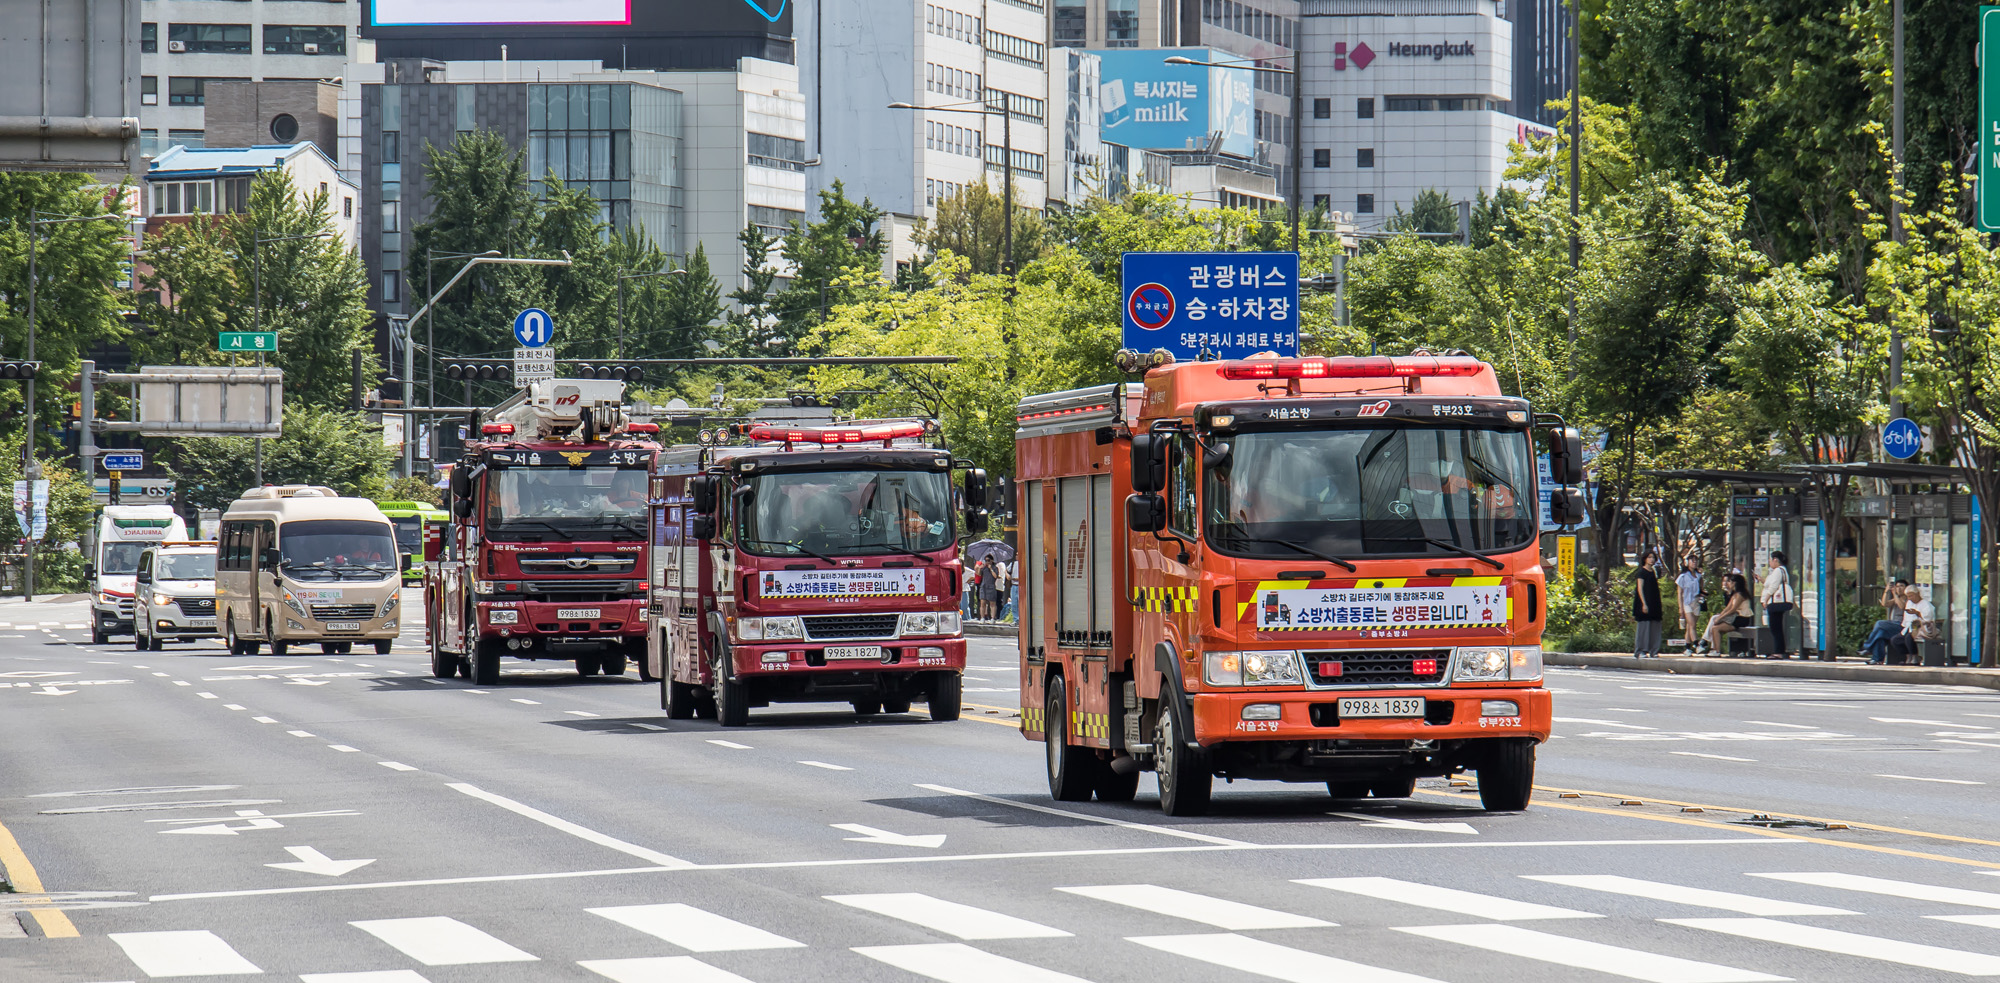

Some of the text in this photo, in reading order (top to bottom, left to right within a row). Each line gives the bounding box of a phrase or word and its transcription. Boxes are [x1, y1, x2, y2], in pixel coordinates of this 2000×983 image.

[1388, 40, 1475, 61] Heungkuk
[1133, 81, 1198, 99] 복사지는
[1134, 100, 1189, 122] miilk
[1188, 264, 1287, 288] 관광버스
[1136, 302, 1169, 310] 주차금지
[1185, 296, 1290, 320] 승·하차장
[230, 335, 265, 348] 시청
[1235, 332, 1270, 348] 과태료
[1272, 332, 1296, 348] 부과
[516, 350, 553, 359] 좌회전시
[516, 363, 553, 372] 보행신호시
[555, 394, 580, 405] 119
[1268, 407, 1311, 419] 서울소방
[1358, 400, 1391, 416] 119
[1431, 404, 1474, 416] 중부23호
[514, 452, 637, 465] 서울 소방
[786, 580, 899, 593] 소방차출동로는 생명로입니다
[1320, 591, 1445, 602] 소방차 길터주기에 동참해주세요
[1297, 604, 1469, 624] 소방차출동로는 생명로입니다
[827, 647, 878, 658] 998소 1827
[760, 662, 790, 671] 서울소방
[1343, 699, 1420, 714] 998소 1839
[1235, 720, 1280, 732] 서울소방
[1477, 717, 1522, 728] 중부23호
